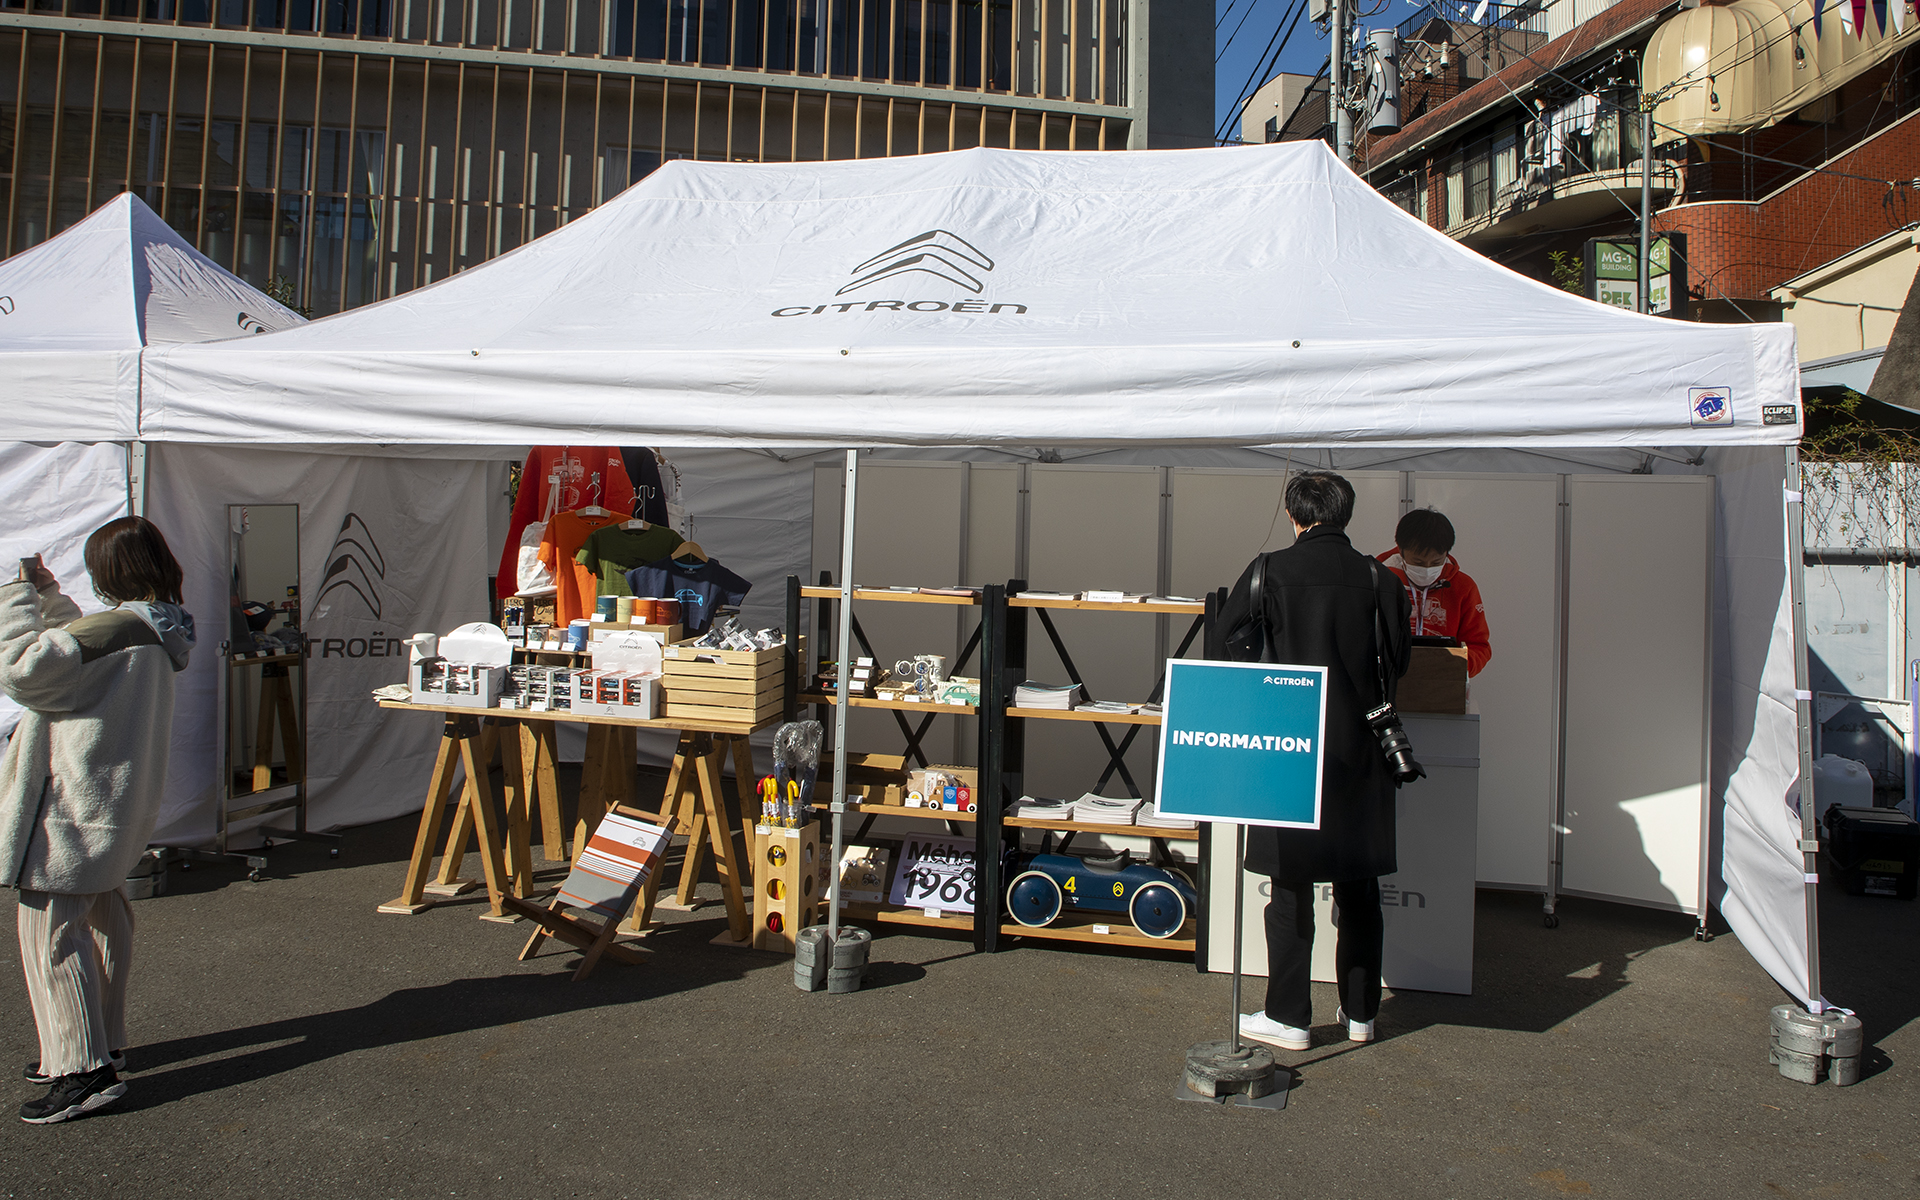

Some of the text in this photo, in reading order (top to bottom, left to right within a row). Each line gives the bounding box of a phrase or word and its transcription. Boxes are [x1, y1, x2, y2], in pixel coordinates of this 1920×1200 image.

[1601, 252, 1632, 263] MG-1
[1601, 264, 1632, 272] BUILDING
[1764, 406, 1793, 415] ECLIPSE
[306, 631, 403, 659] TROËN
[1273, 677, 1314, 687] CITROËN
[1172, 730, 1311, 753] INFORMATION
[1063, 876, 1077, 893] 4
